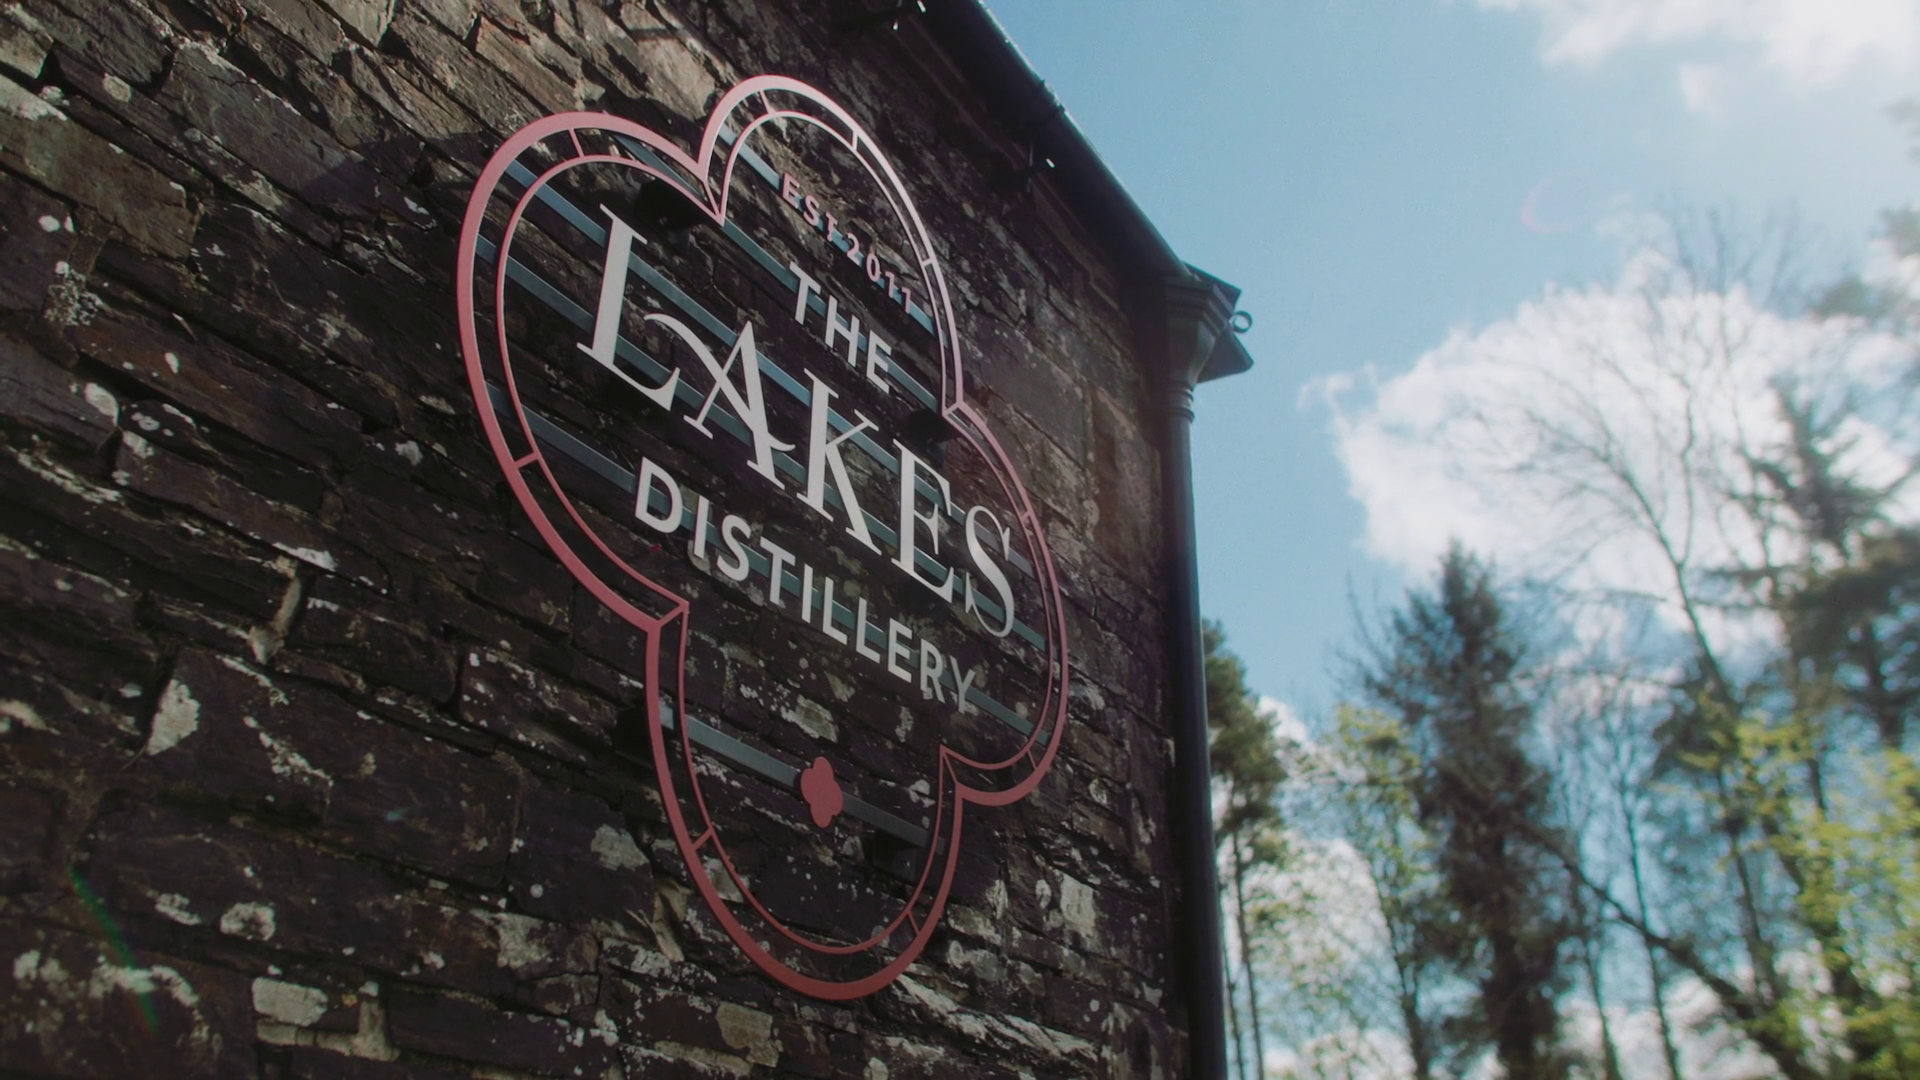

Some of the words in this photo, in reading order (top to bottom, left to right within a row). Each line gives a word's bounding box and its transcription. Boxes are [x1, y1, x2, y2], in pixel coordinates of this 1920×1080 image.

[782, 172, 838, 242] EST
[846, 232, 911, 314] 2011
[789, 261, 892, 394] THE
[577, 204, 1014, 637] LAKES
[635, 457, 975, 714] DISTILLERY
